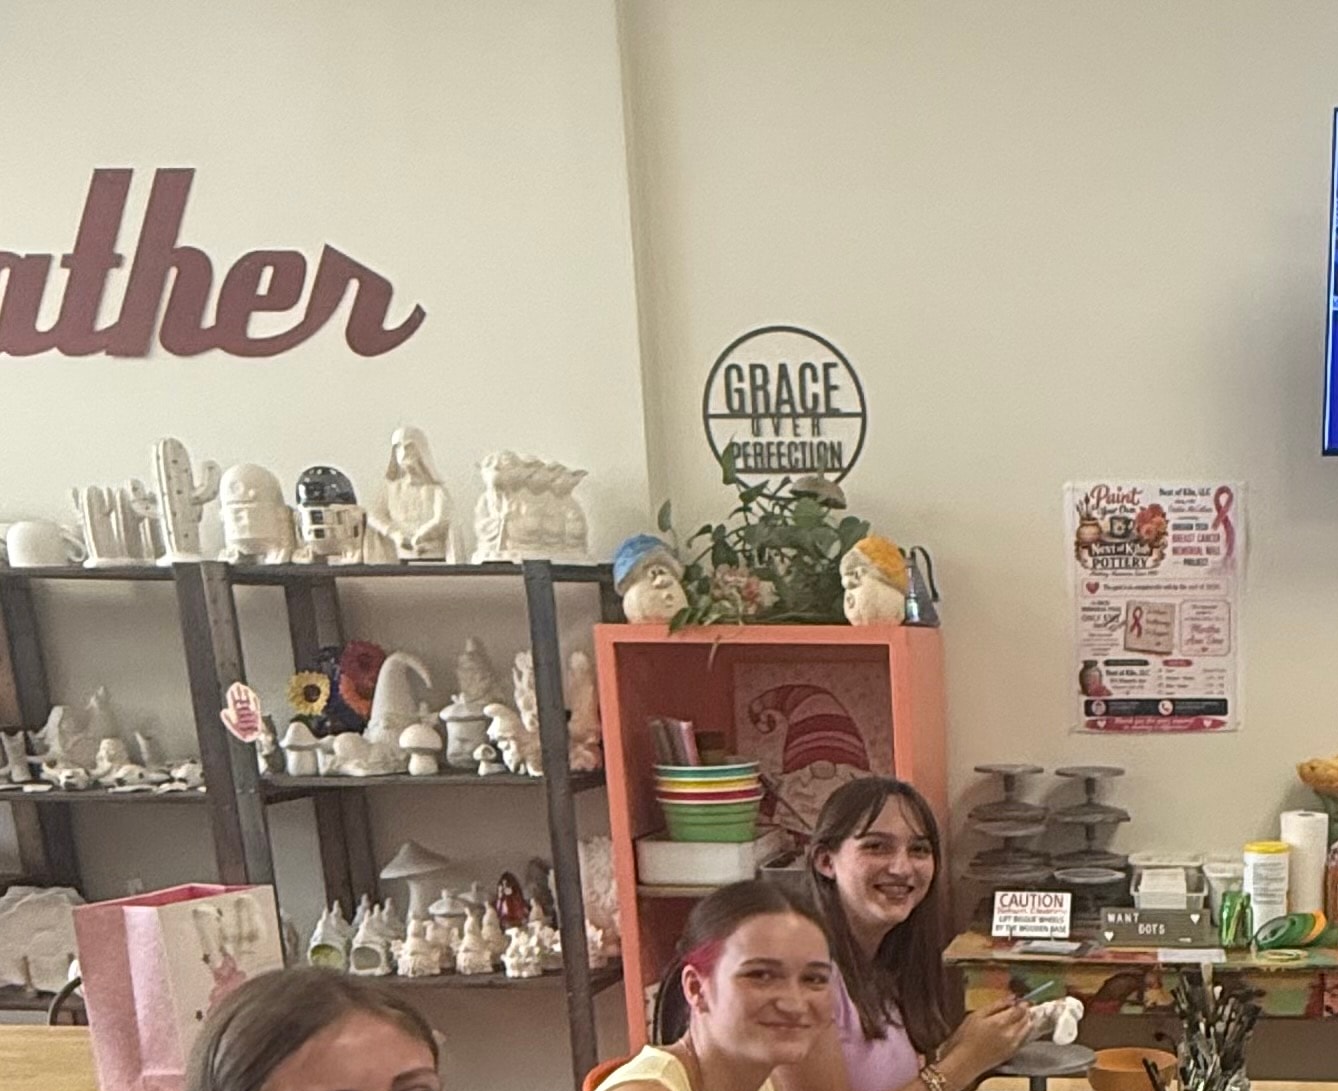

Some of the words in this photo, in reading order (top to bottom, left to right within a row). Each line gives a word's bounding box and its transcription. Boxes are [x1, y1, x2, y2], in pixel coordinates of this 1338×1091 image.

[724, 362, 841, 414] GRACE
[752, 415, 822, 437] OVER
[732, 440, 843, 469] PERFECTION
[1090, 484, 1143, 510] Paint
[1092, 557, 1148, 569] POTTERY
[1000, 893, 1065, 909] CAUTION
[1107, 912, 1140, 923] WANT
